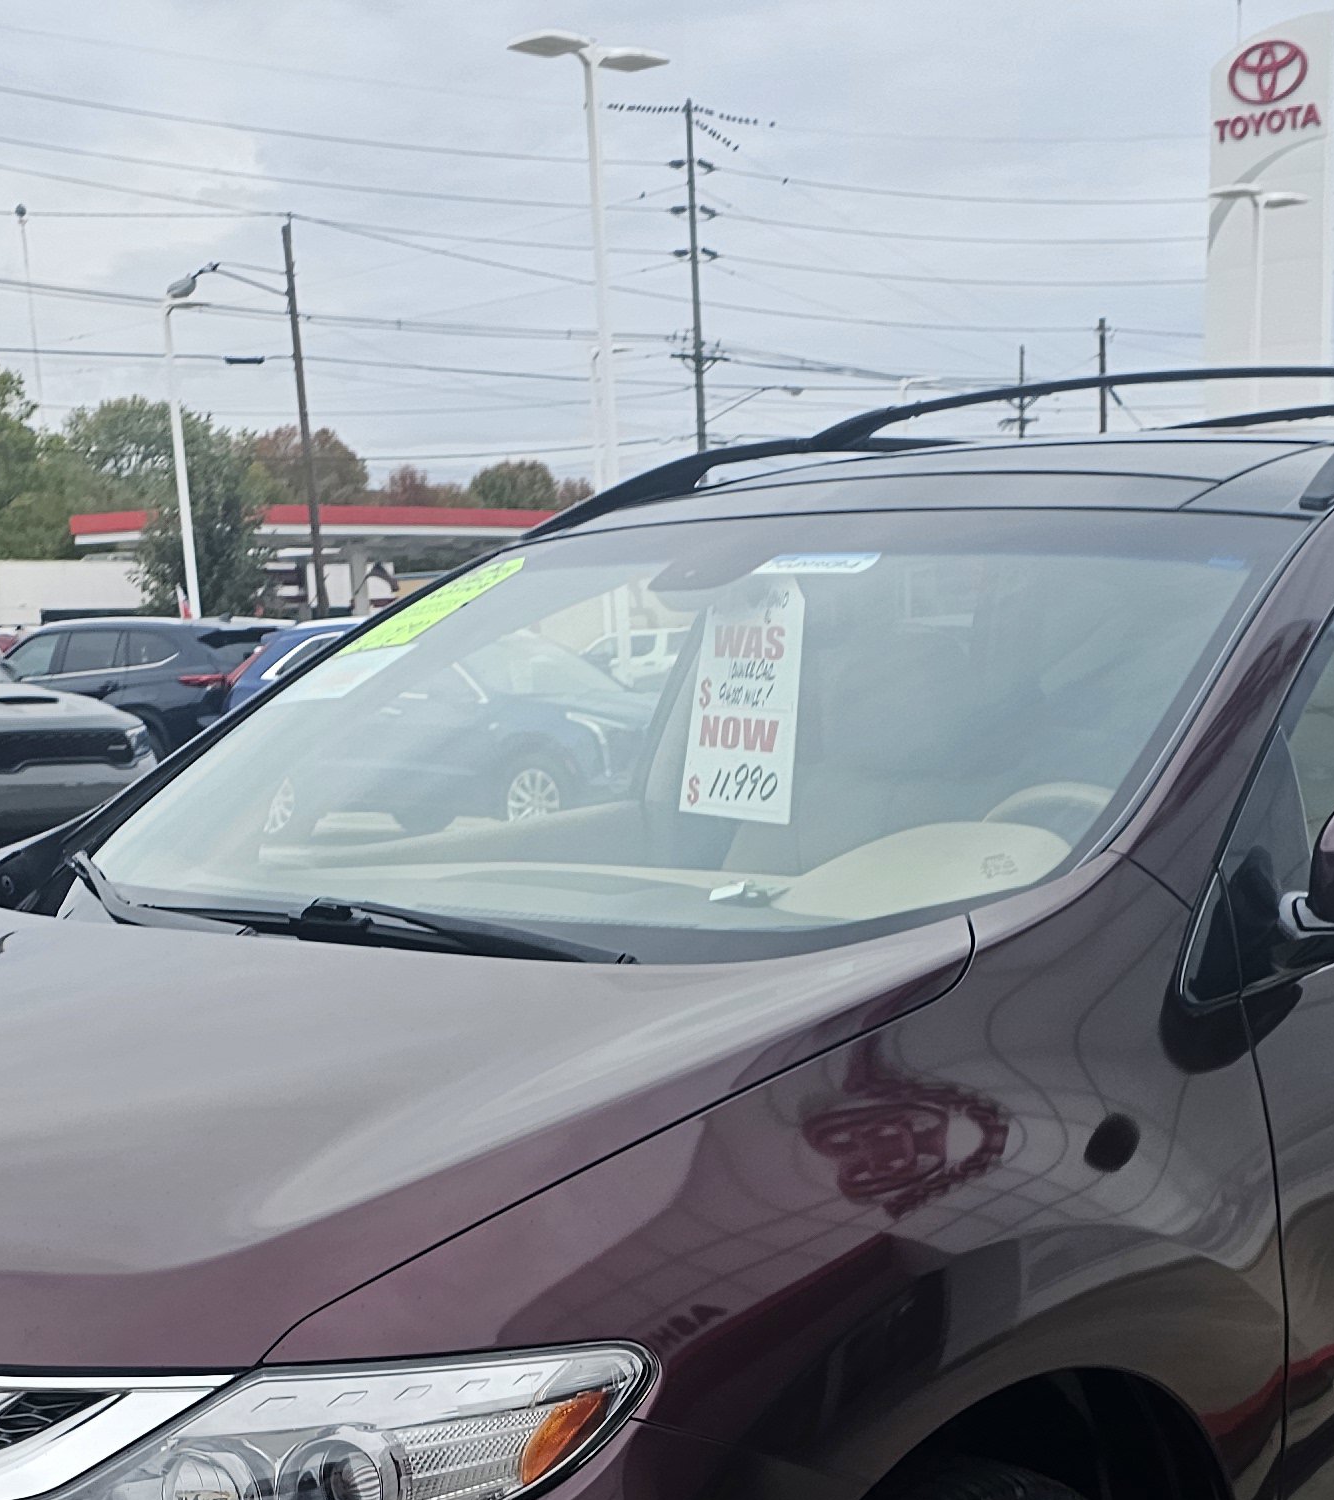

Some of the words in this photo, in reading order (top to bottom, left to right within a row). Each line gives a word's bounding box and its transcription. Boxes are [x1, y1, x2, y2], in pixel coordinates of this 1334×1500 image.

[1213, 103, 1322, 144] TOYOTA
[714, 624, 786, 661] WAS
[699, 676, 712, 710] $
[699, 715, 780, 753] NOW
[687, 774, 700, 806] $
